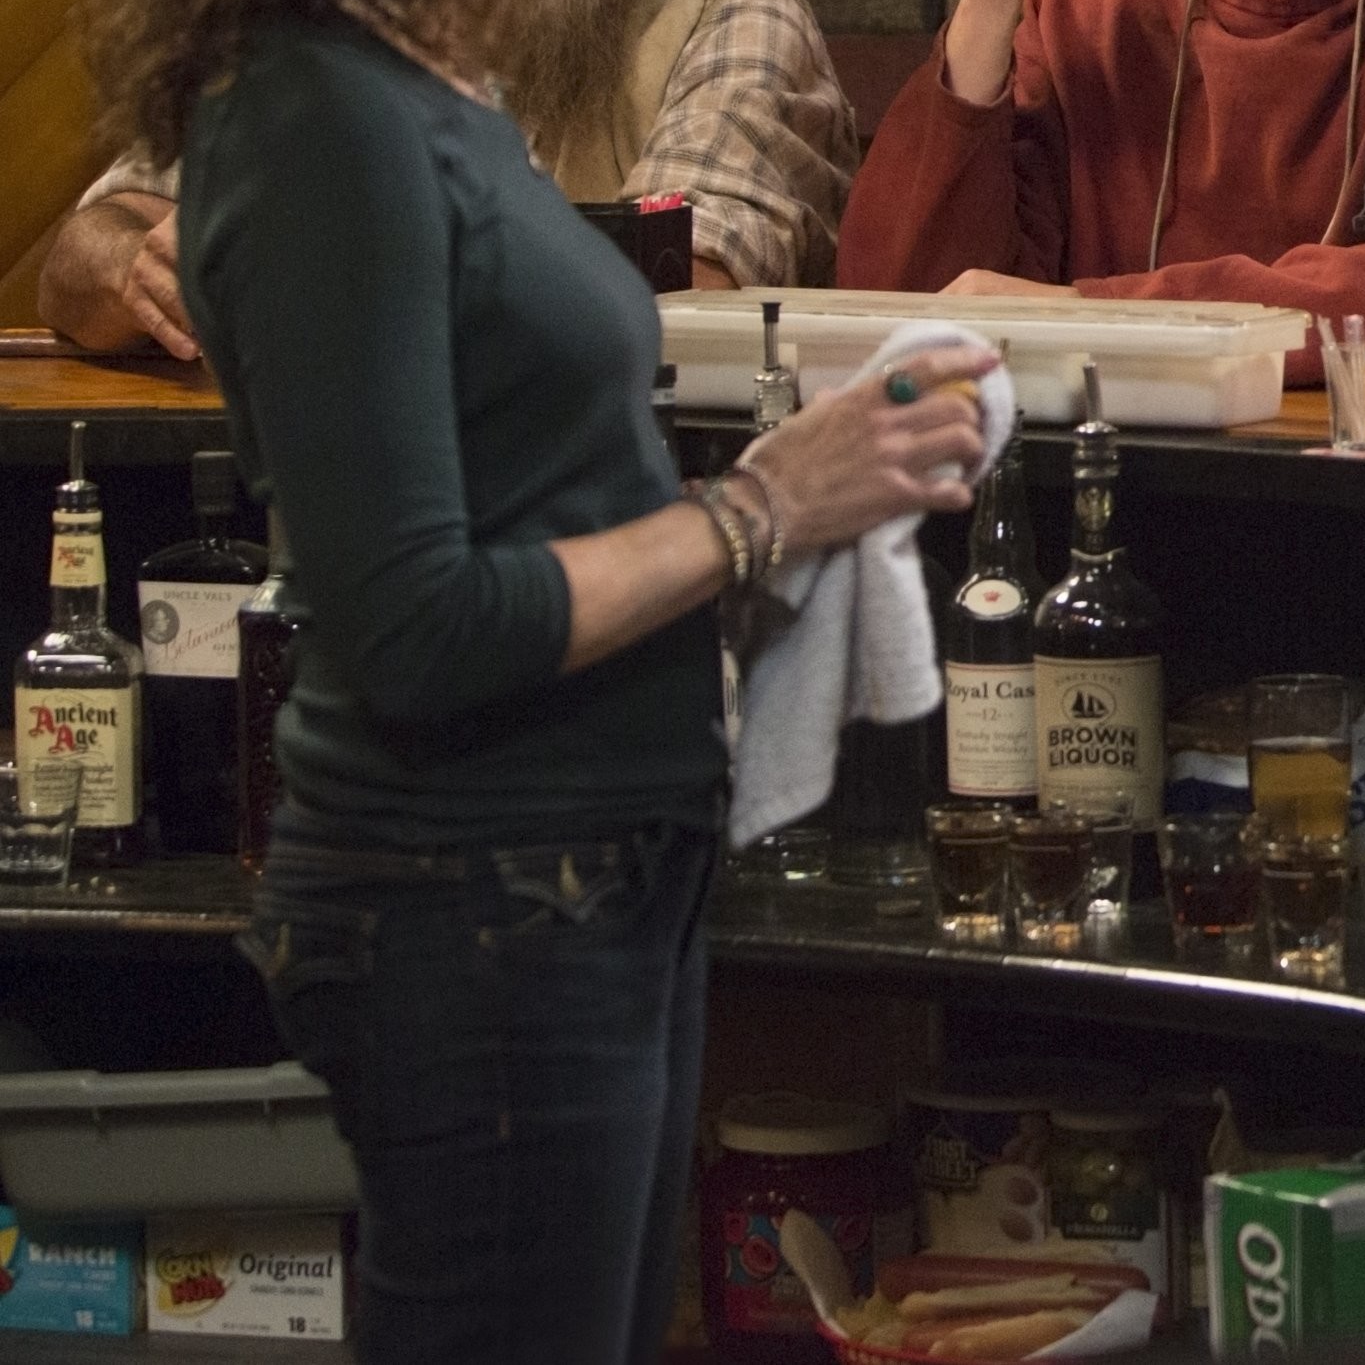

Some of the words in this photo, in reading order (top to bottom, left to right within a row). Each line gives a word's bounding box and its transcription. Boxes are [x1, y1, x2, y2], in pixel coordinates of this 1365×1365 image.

[163, 590, 199, 601] UNCLE
[28, 701, 119, 738] Ancient
[48, 724, 99, 754] Age
[1049, 725, 1136, 748] BROWN
[1049, 747, 1137, 767] LIQUOR
[240, 1253, 334, 1281] Original
[288, 1316, 306, 1332] 18
